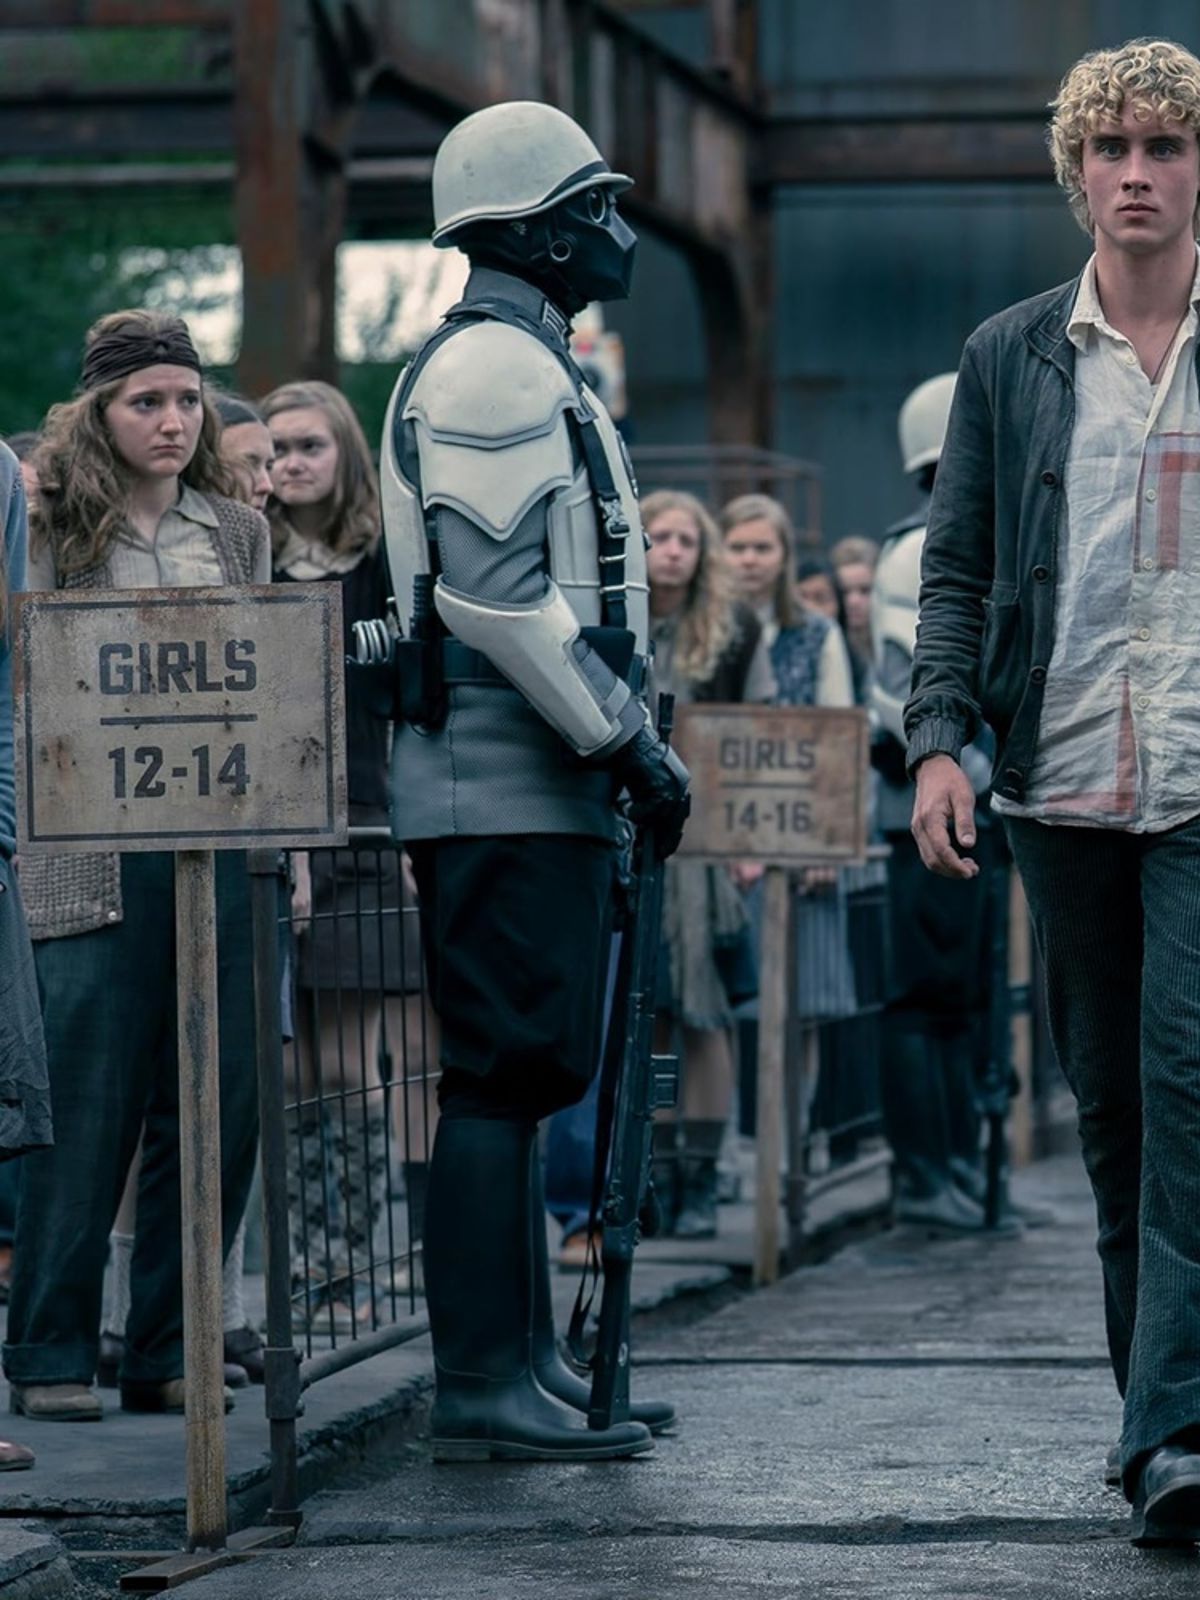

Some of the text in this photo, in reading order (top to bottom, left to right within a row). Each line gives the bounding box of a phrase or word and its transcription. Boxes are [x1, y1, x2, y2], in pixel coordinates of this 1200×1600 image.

[99, 639, 257, 695] GIRLS
[108, 743, 250, 799] 12-14
[720, 737, 816, 770] GIRLS
[722, 801, 812, 833] 14-16
